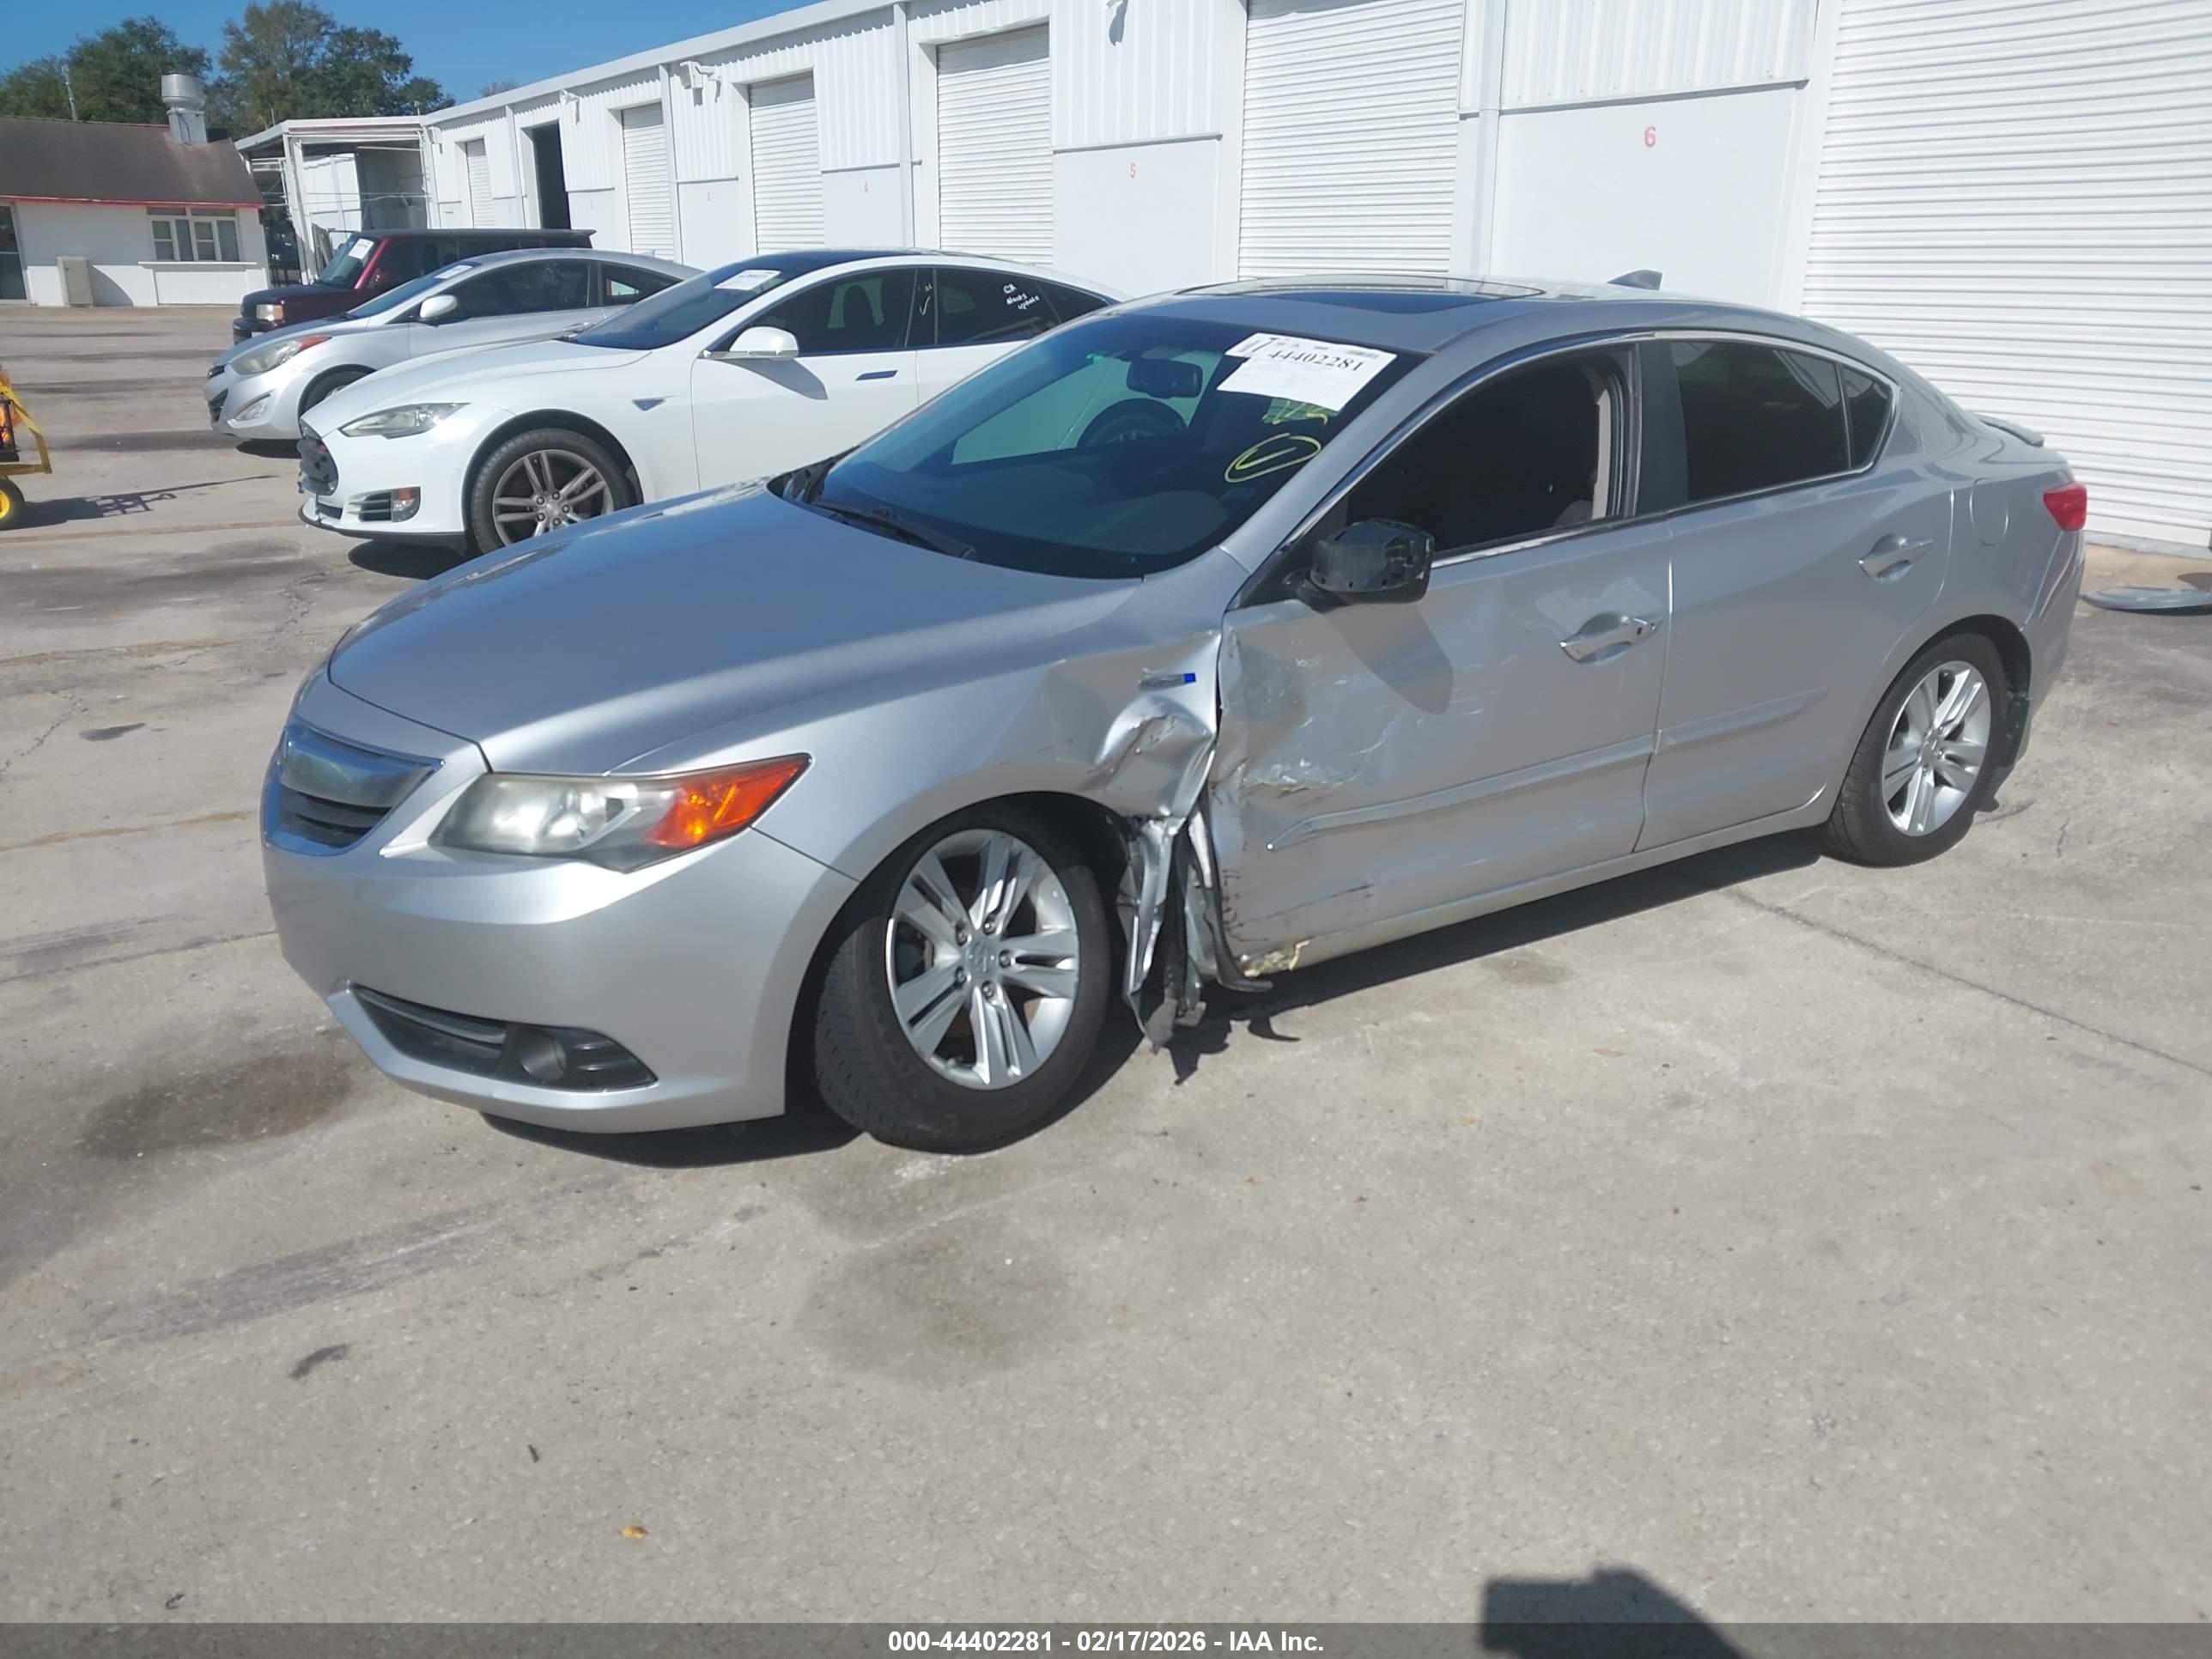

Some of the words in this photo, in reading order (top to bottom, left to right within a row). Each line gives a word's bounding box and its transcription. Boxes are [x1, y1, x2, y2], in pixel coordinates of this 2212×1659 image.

[1644, 125, 1656, 148] 6
[1129, 162, 1136, 179] 5
[1267, 349, 1364, 371] 44402281
